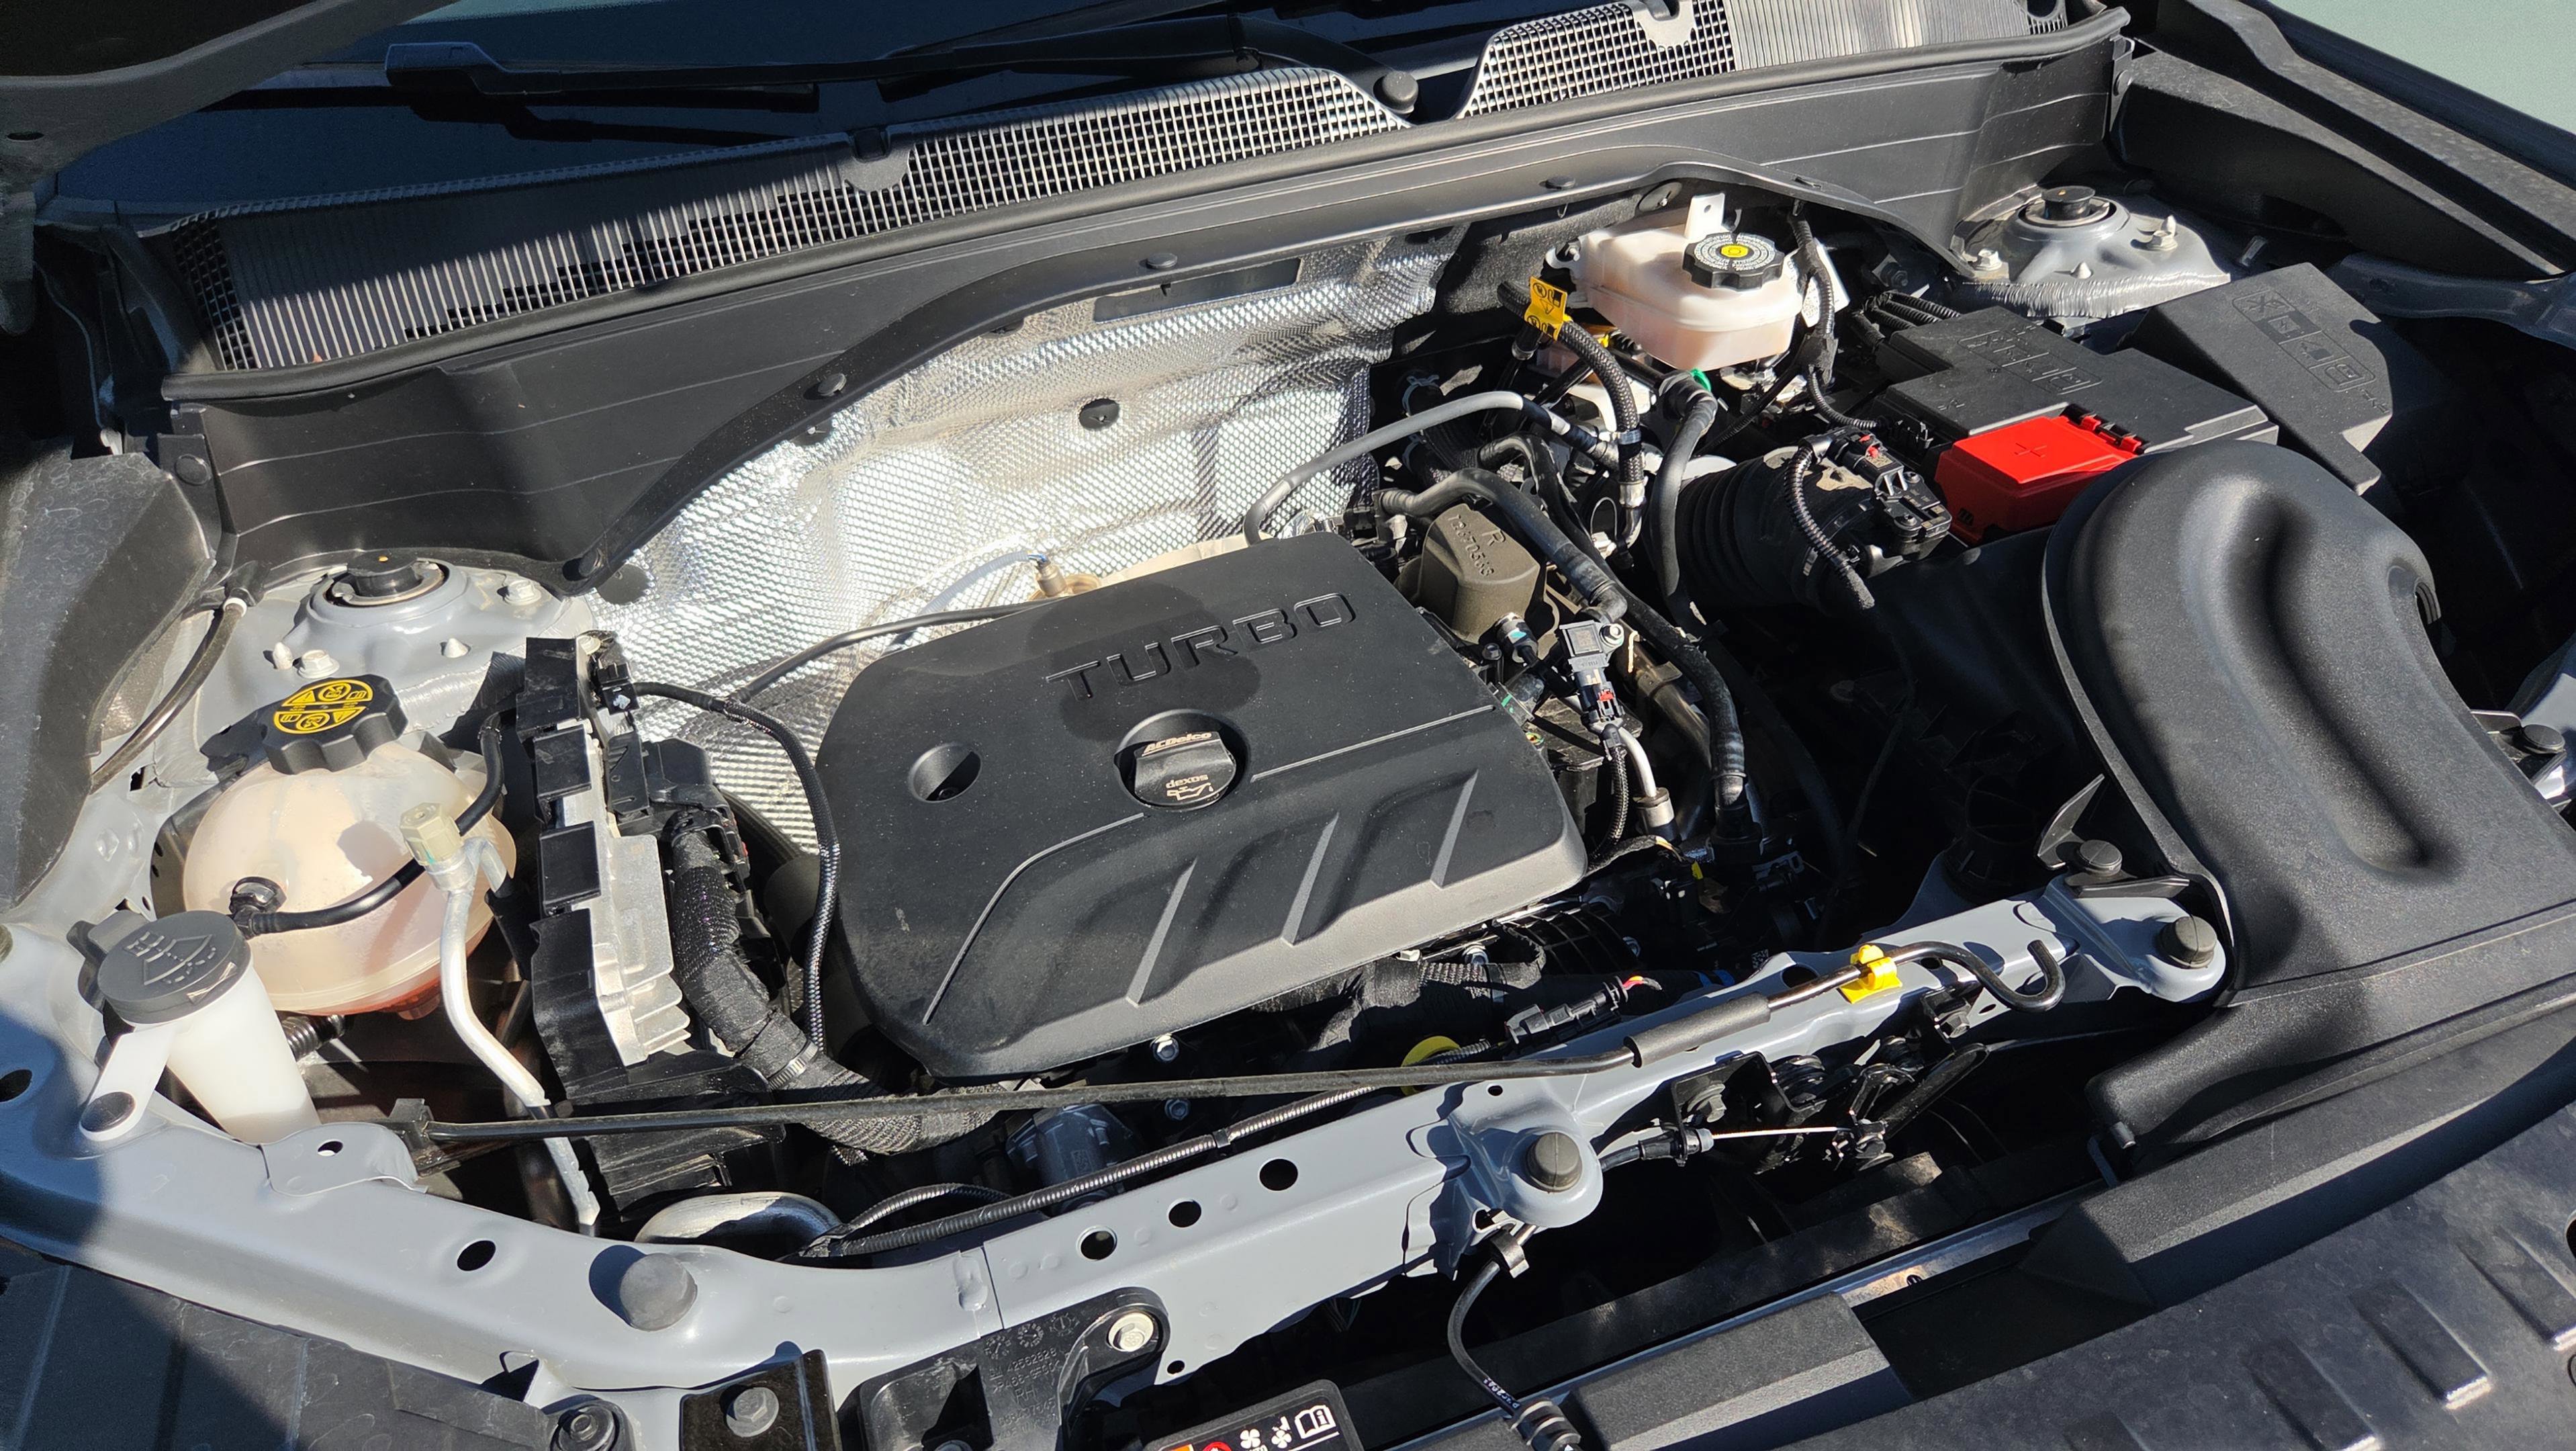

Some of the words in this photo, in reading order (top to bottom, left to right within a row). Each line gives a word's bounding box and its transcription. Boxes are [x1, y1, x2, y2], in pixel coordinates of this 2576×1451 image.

[1046, 591, 1356, 701] TURBO
[1143, 732, 1213, 754] ACDelco
[1166, 775, 1208, 789] dexos
[1015, 1384, 1038, 1404] RH
